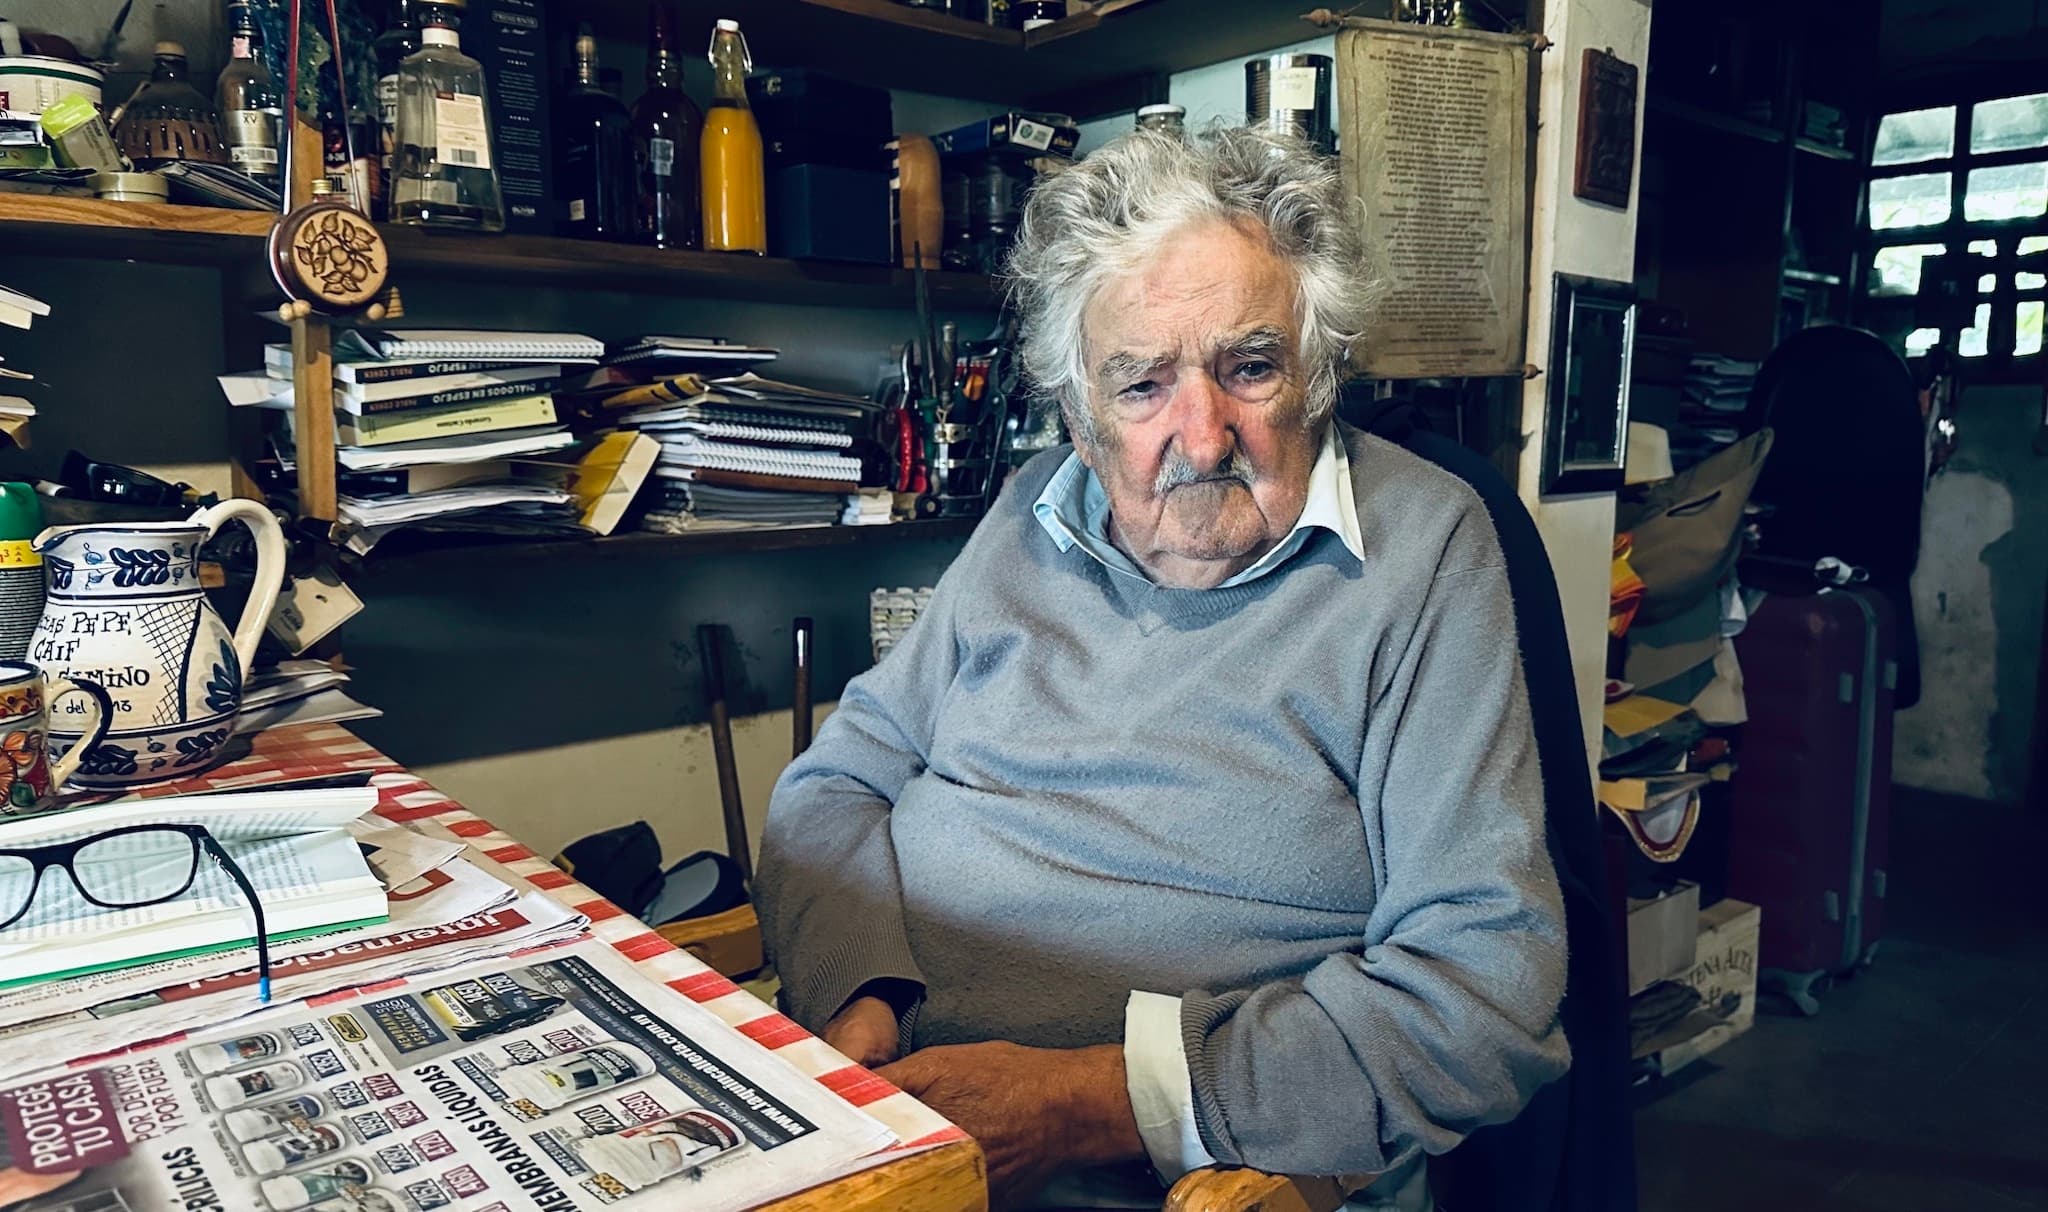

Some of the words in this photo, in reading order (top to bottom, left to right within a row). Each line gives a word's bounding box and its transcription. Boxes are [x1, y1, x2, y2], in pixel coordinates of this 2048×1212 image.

[390, 368, 412, 376] PABLO
[428, 362, 466, 372] ESPEJO
[395, 399, 416, 408] PABLO
[432, 390, 469, 403] ESPEJO
[472, 389, 484, 398] EN
[139, 1057, 171, 1092] FUERA
[629, 1012, 806, 1136] www.laquincalleria.com.uy
[62, 1073, 103, 1123] CASA
[115, 1064, 149, 1111] DENTRO
[413, 1062, 487, 1121] LÍQUIDAS
[491, 1091, 505, 1100] LA
[156, 1094, 183, 1120] POR
[6, 1083, 71, 1166] PROTEGÉ
[132, 1116, 159, 1141] POR
[165, 1122, 187, 1133] Y
[75, 1129, 113, 1155] TU
[473, 1117, 580, 1210] MEMBRANAS
[580, 1177, 619, 1203] PROMO
